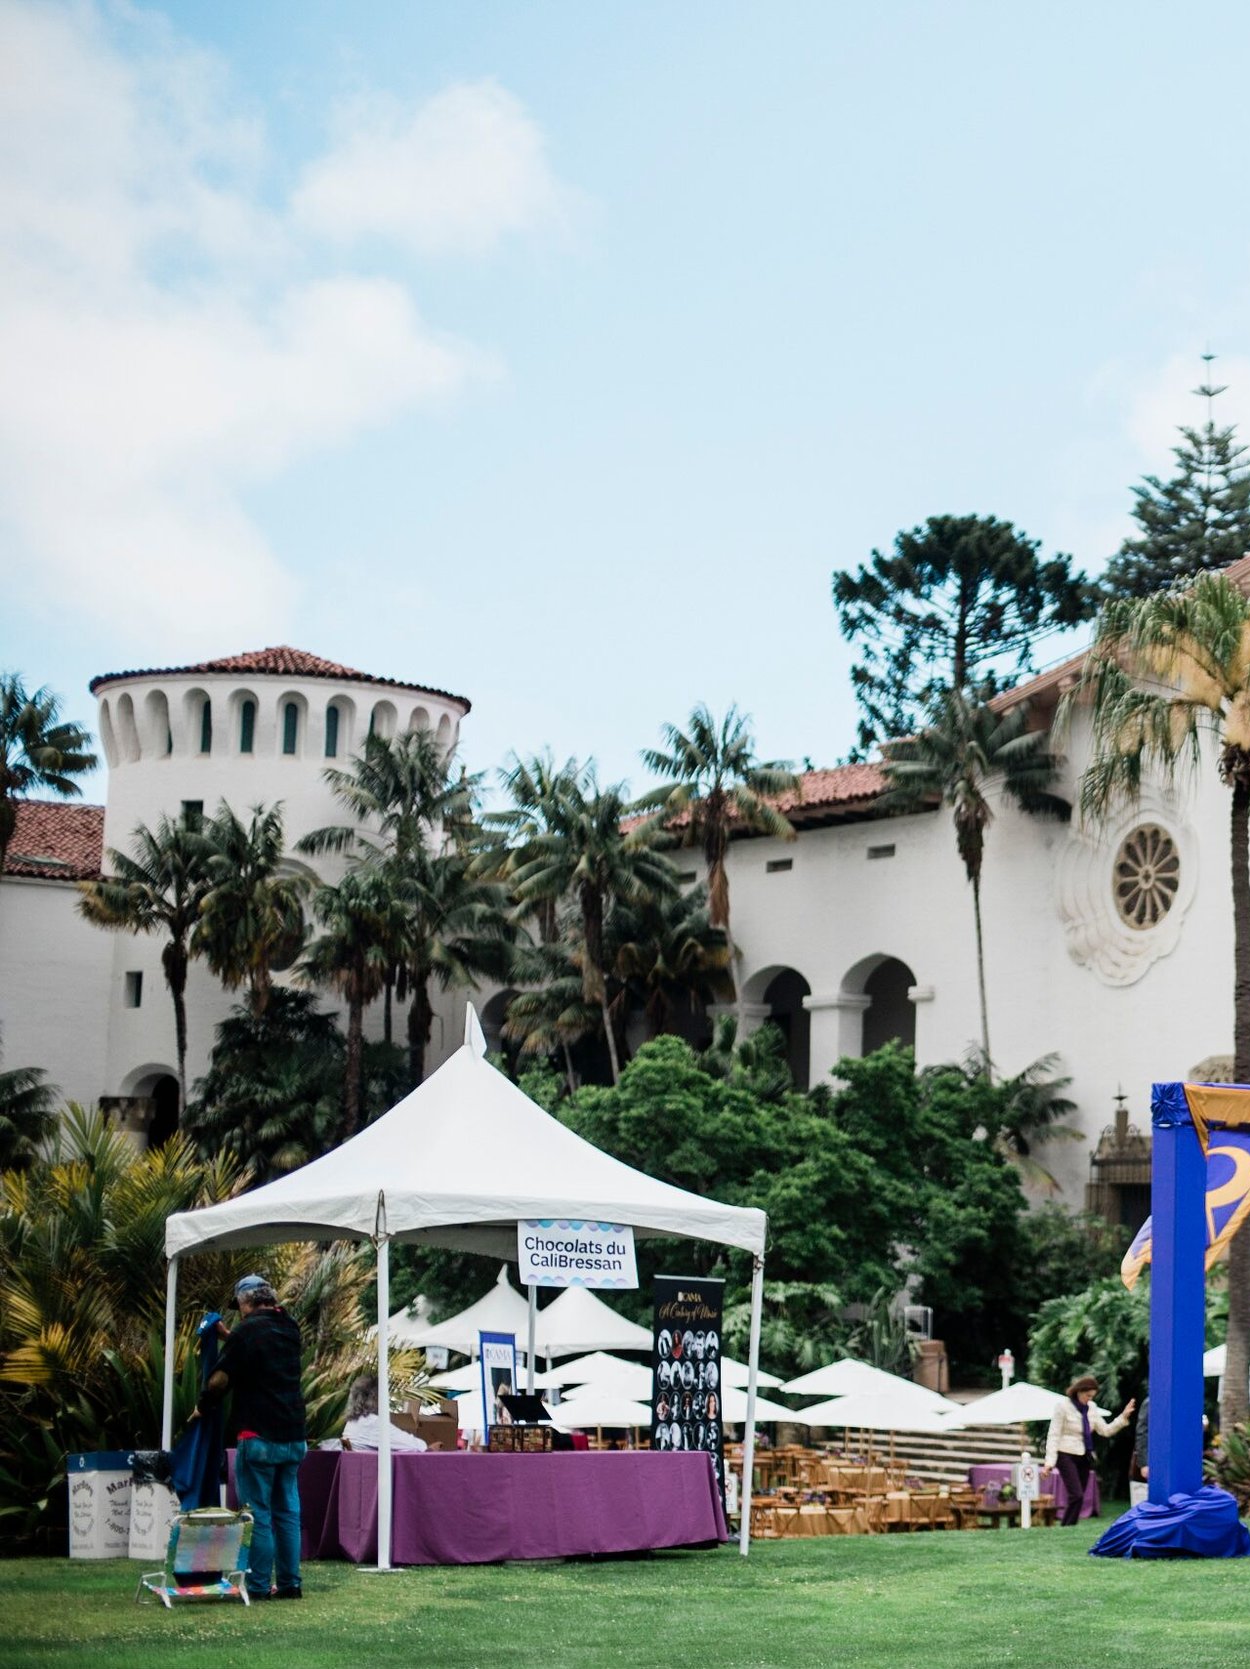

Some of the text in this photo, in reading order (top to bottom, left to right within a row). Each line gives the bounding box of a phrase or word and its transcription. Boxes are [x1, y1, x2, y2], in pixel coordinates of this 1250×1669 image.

[525, 1236, 626, 1255] Chocolats du
[530, 1253, 622, 1270] CaliBressan
